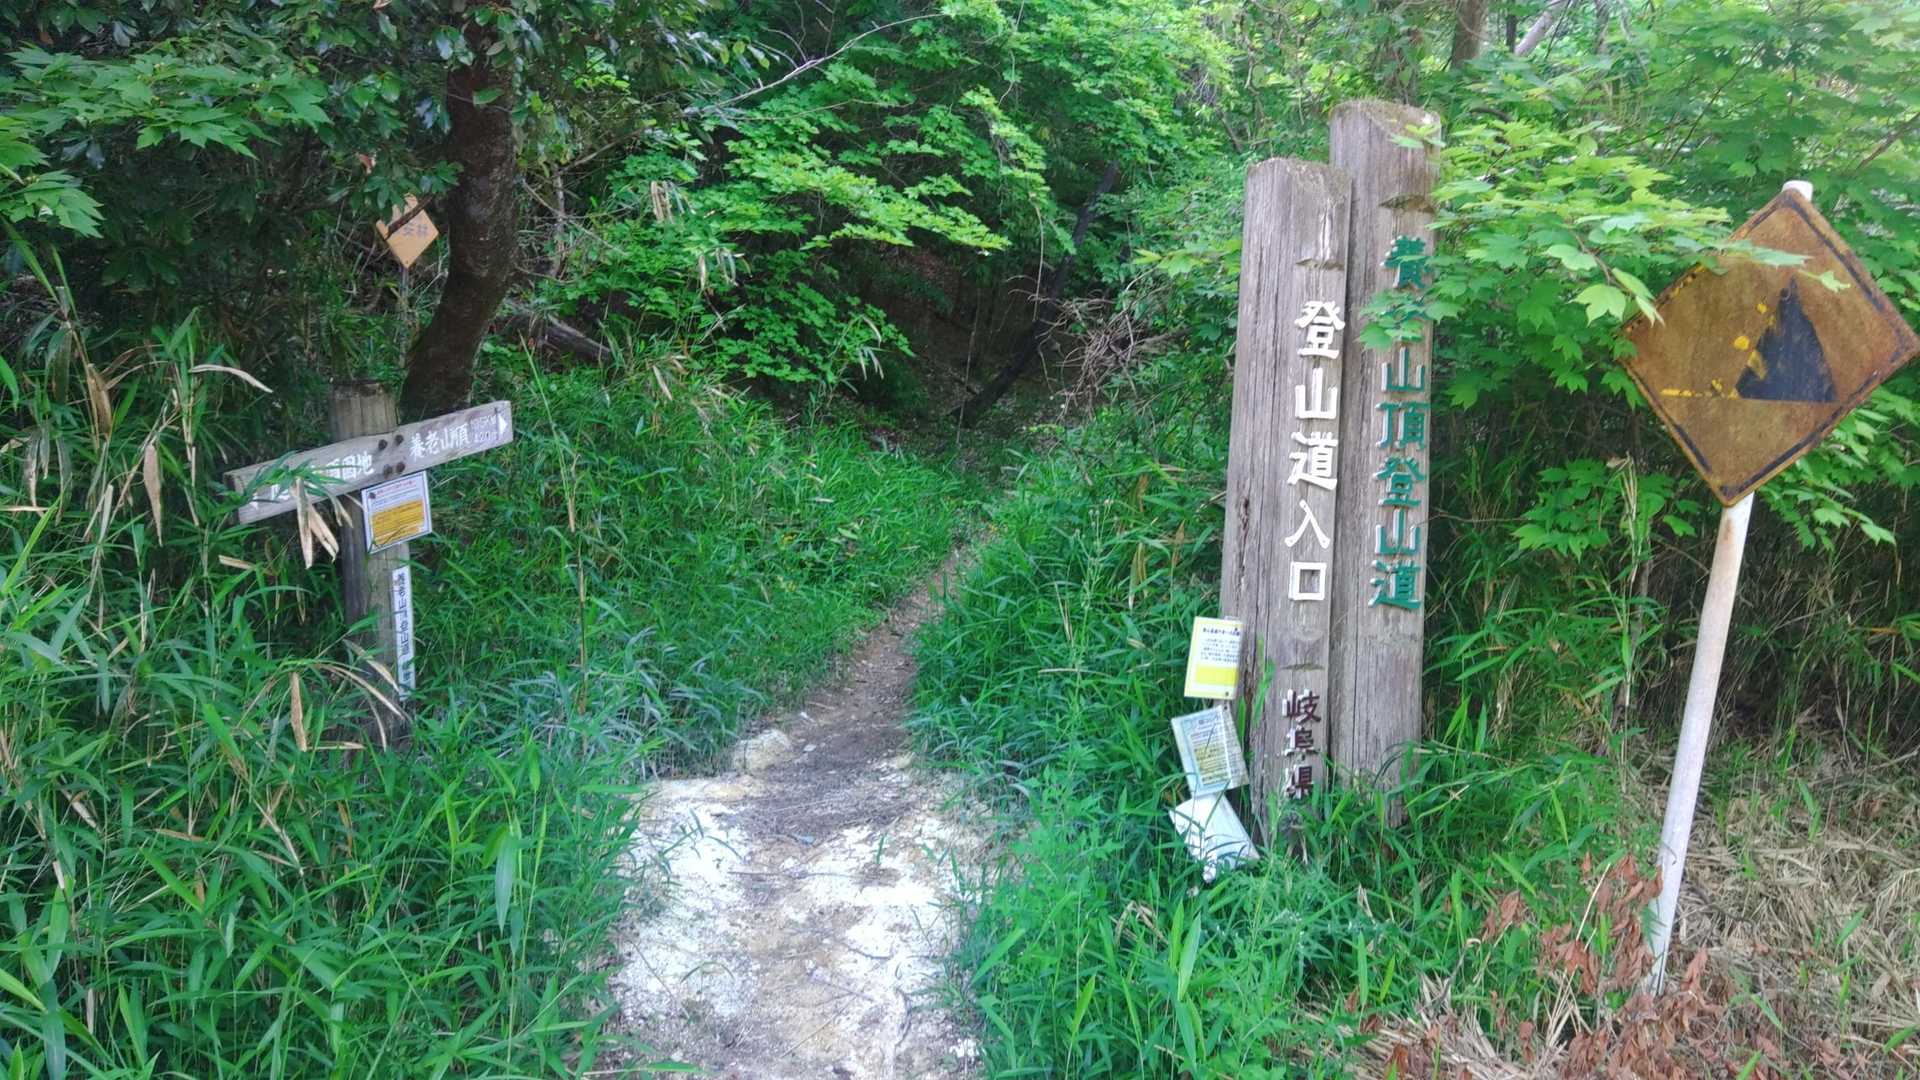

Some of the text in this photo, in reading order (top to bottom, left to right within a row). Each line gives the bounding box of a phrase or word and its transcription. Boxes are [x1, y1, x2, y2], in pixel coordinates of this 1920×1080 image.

[1284, 301, 1345, 601] 登山道入口
[1282, 688, 1321, 799] 岐阜県
